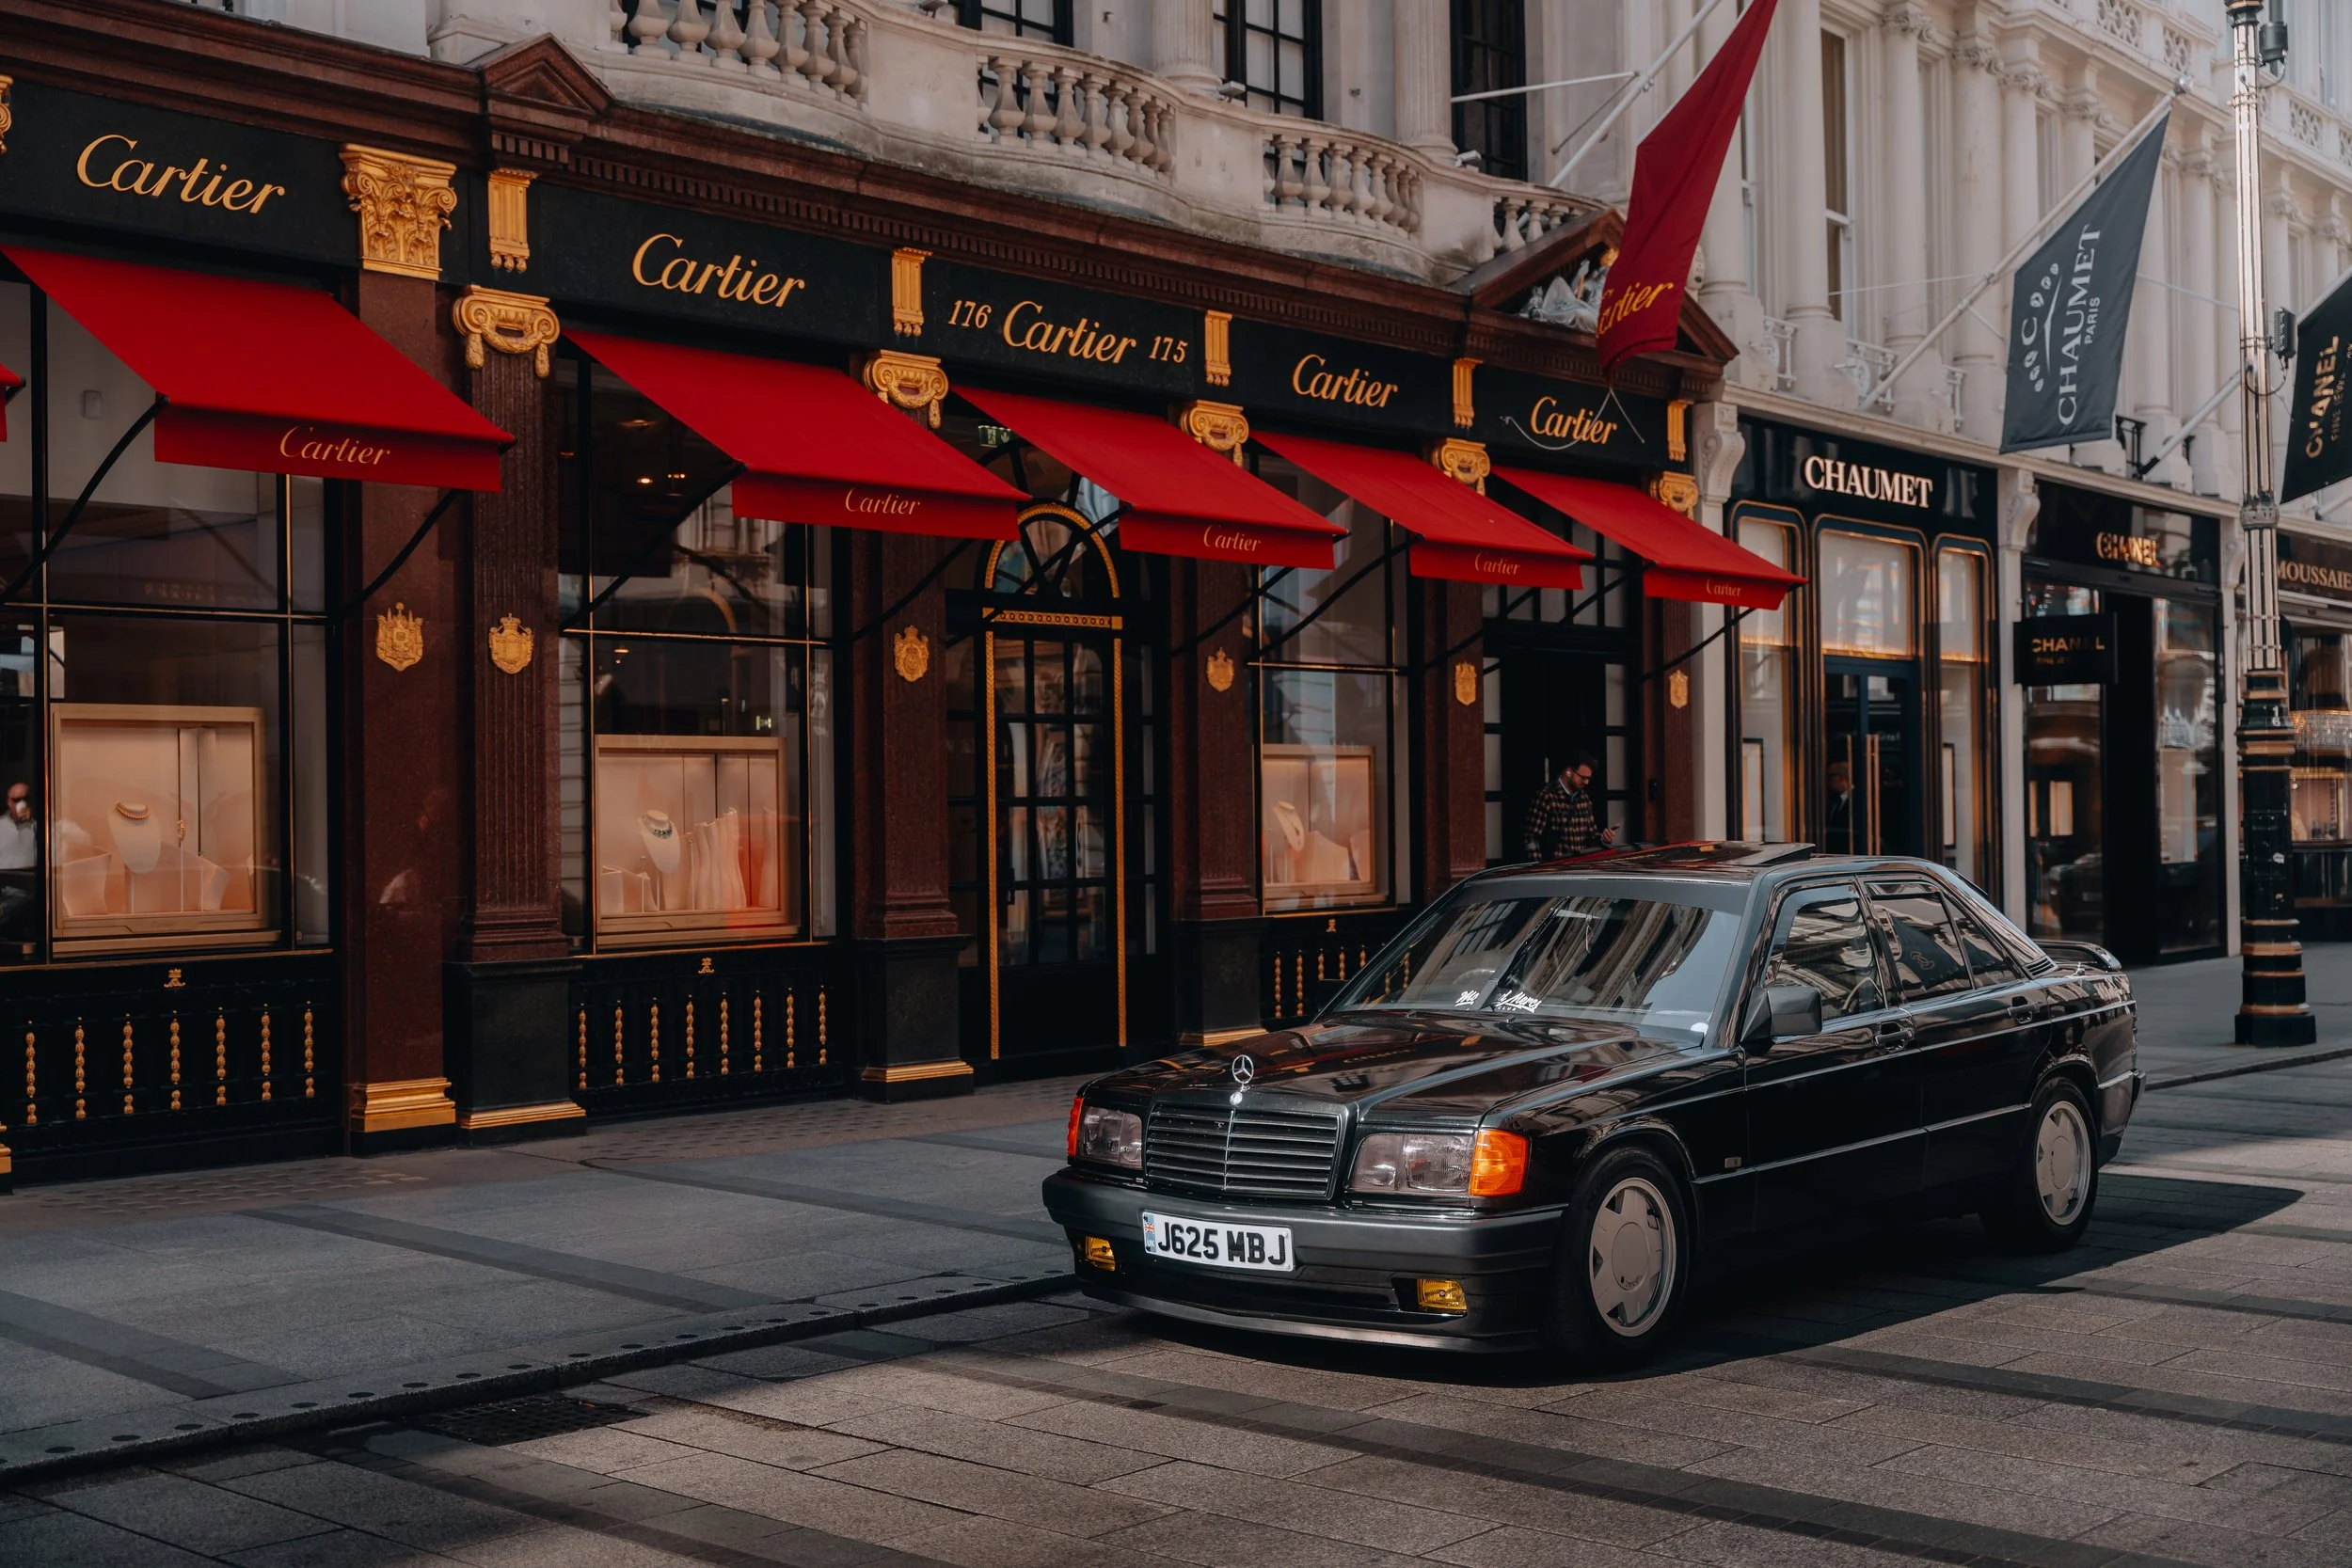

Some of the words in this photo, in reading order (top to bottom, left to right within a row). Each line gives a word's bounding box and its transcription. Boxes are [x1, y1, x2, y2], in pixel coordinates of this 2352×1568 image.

[76, 134, 285, 214] Cartier
[632, 233, 805, 308] Cartier
[947, 299, 992, 329] 176
[1002, 300, 1136, 364] Cartier
[1149, 335, 1188, 363] 175
[2058, 224, 2101, 425] CHAUMET
[2084, 296, 2101, 344] PARIS
[1293, 354, 1398, 407] Cartier
[1530, 395, 1618, 445] Cartier
[279, 425, 390, 466] Cartier
[845, 487, 921, 515] Cartier
[1804, 455, 1933, 509] CHAUMET
[1203, 524, 1262, 552] Cartier
[1474, 552, 1521, 575] Cartier
[1706, 578, 1741, 597] Cartier
[1157, 1222, 1219, 1260] J625
[1226, 1229, 1286, 1266] MBJ
